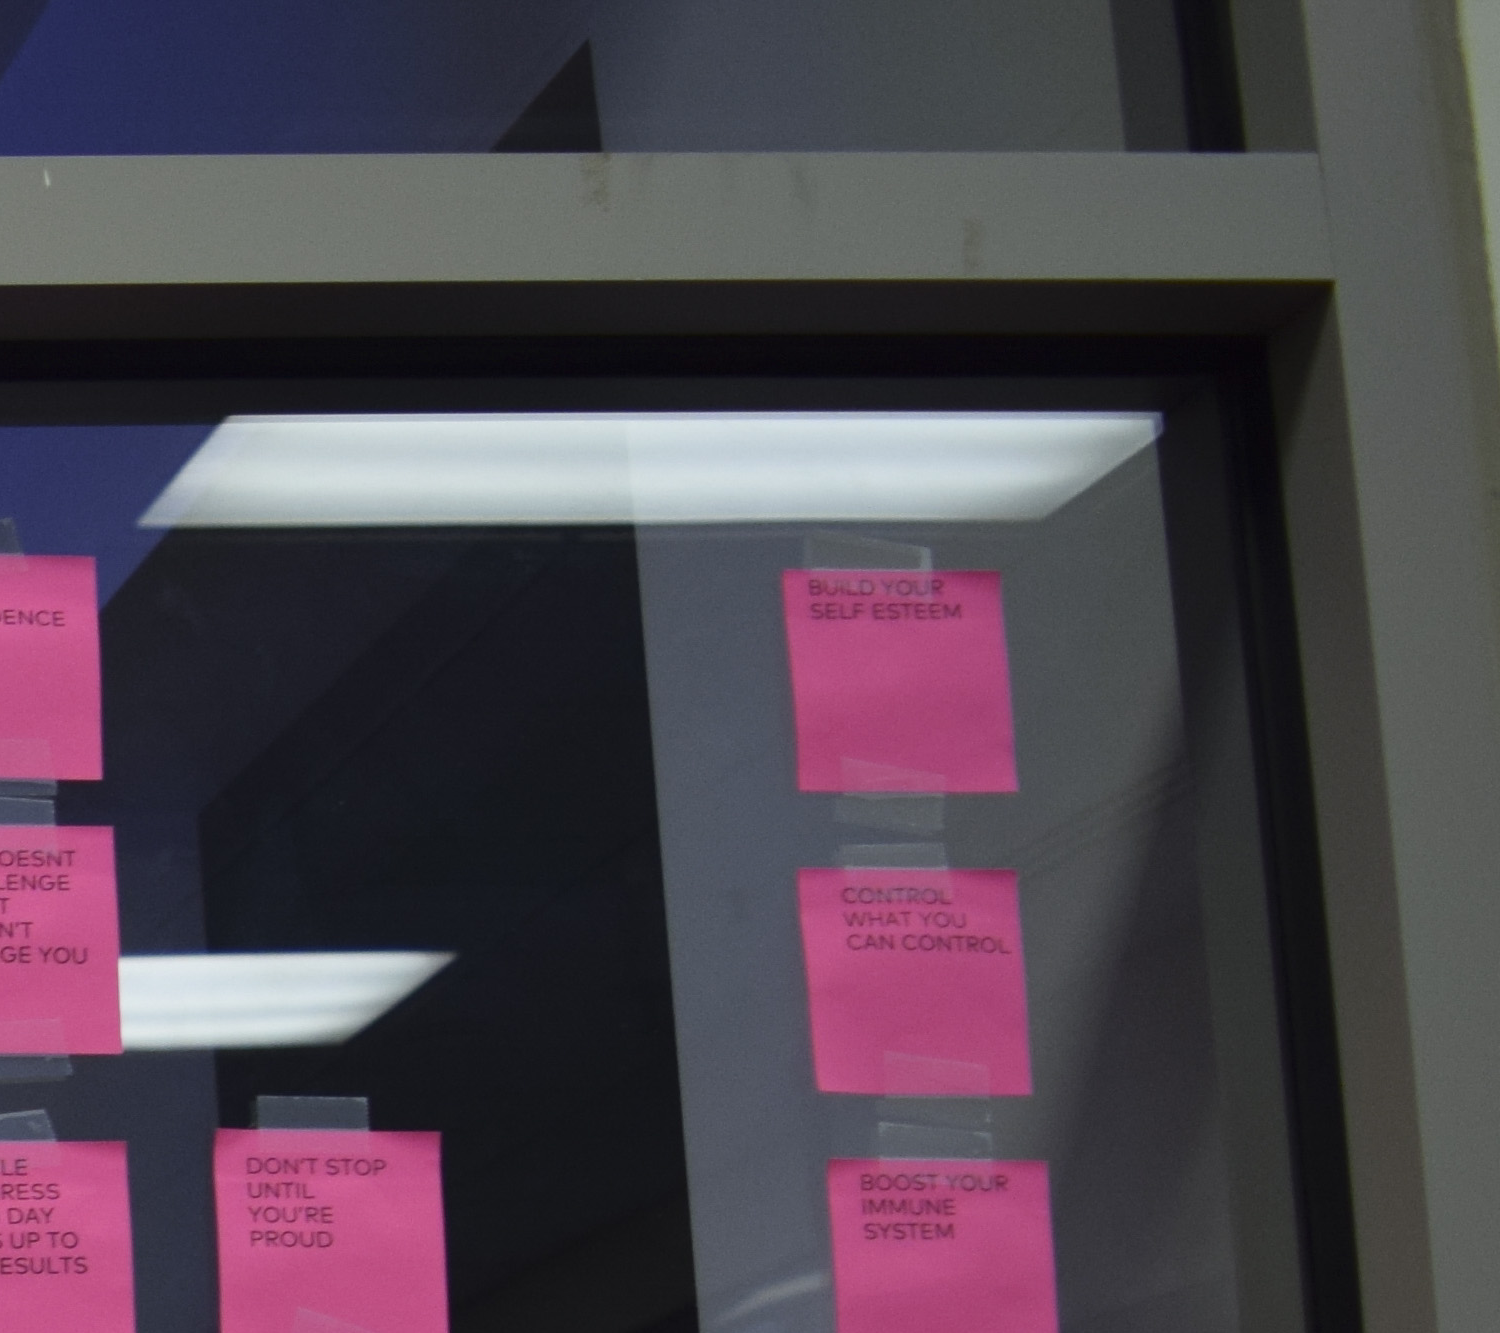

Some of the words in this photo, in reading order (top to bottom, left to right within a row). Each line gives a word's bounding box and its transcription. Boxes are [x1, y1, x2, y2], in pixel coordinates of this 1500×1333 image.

[324, 1157, 388, 1177] STOP
[246, 1181, 316, 1200] UNTIL
[6, 1207, 55, 1225] DAY
[9, 1231, 41, 1250] UP
[45, 1231, 80, 1250] TO
[249, 1229, 334, 1249] PROUD
